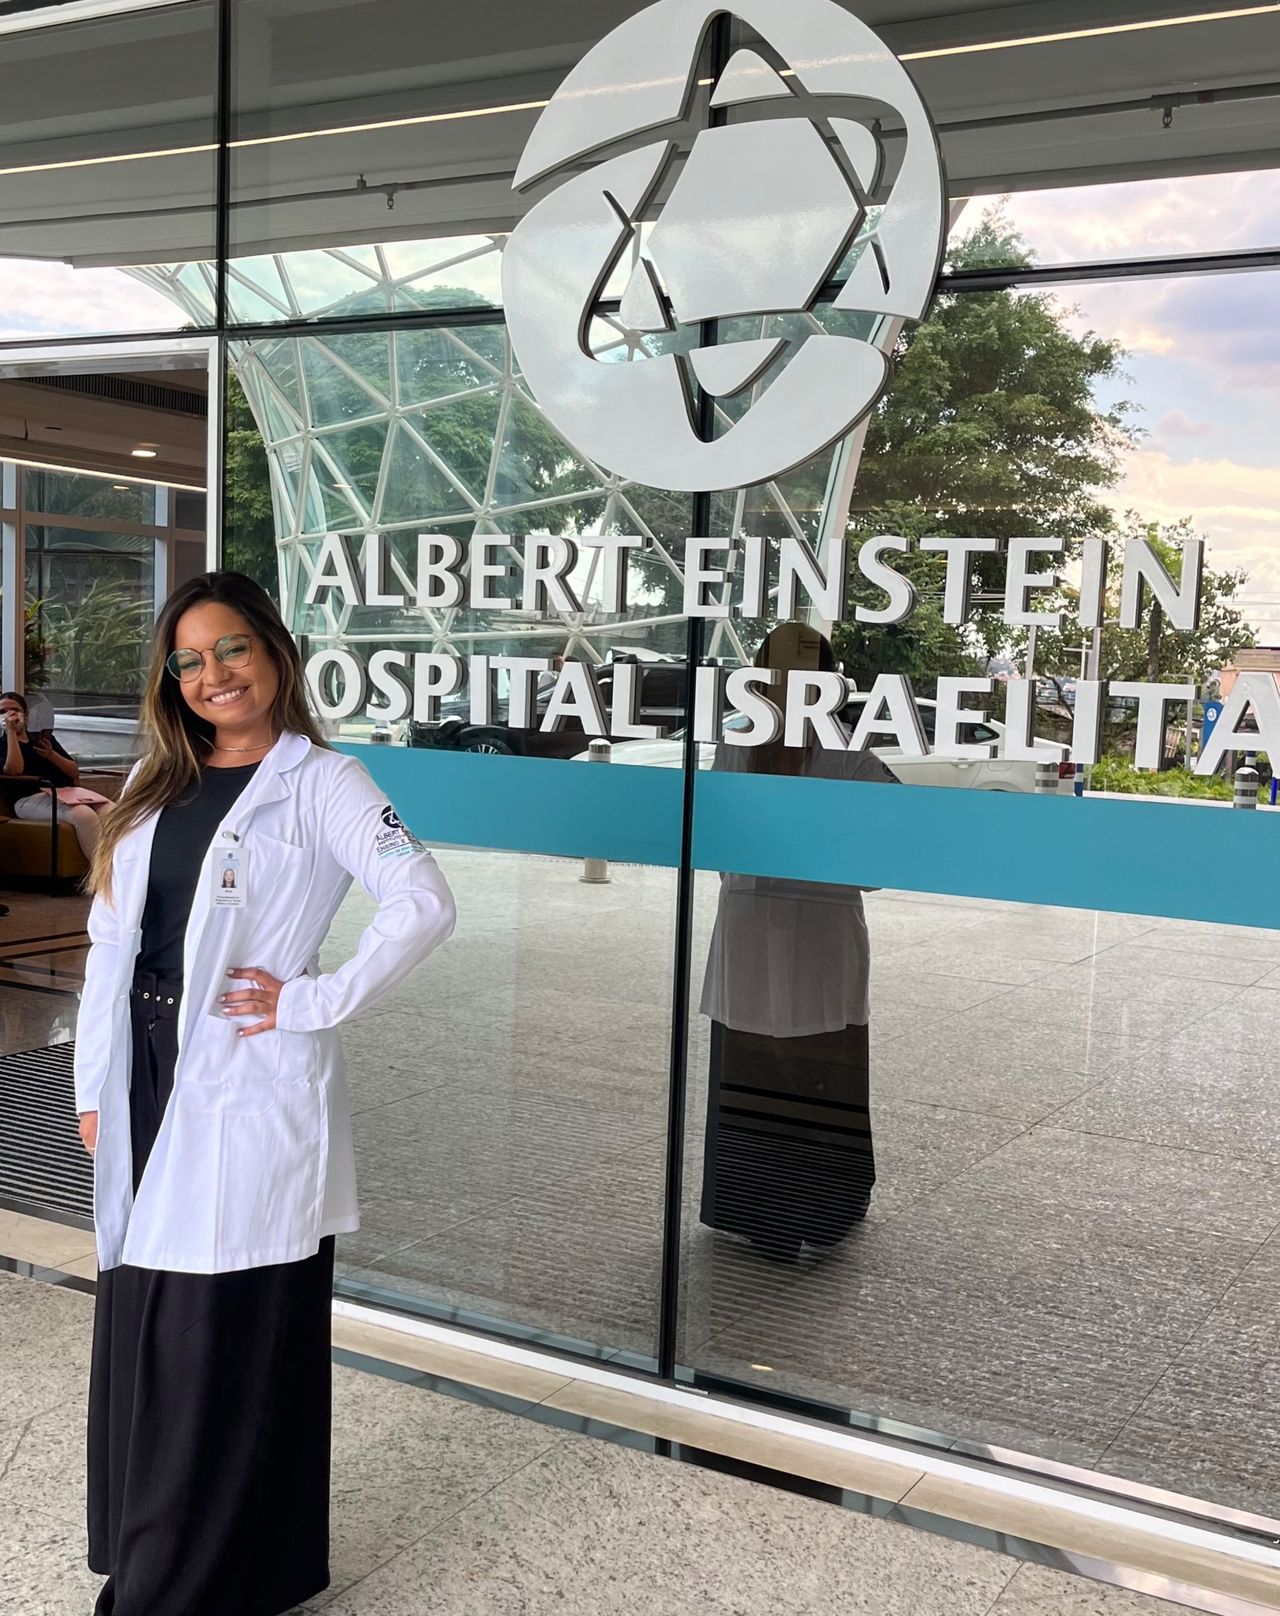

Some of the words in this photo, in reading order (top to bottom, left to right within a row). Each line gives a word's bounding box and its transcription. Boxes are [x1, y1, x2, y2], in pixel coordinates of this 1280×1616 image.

[304, 533, 645, 613] ALBERT
[683, 536, 1202, 630] EINSTEIN
[295, 638, 667, 740] OSPITAL
[693, 666, 1280, 781] ISRAELITA
[376, 829, 400, 841] ALBERT
